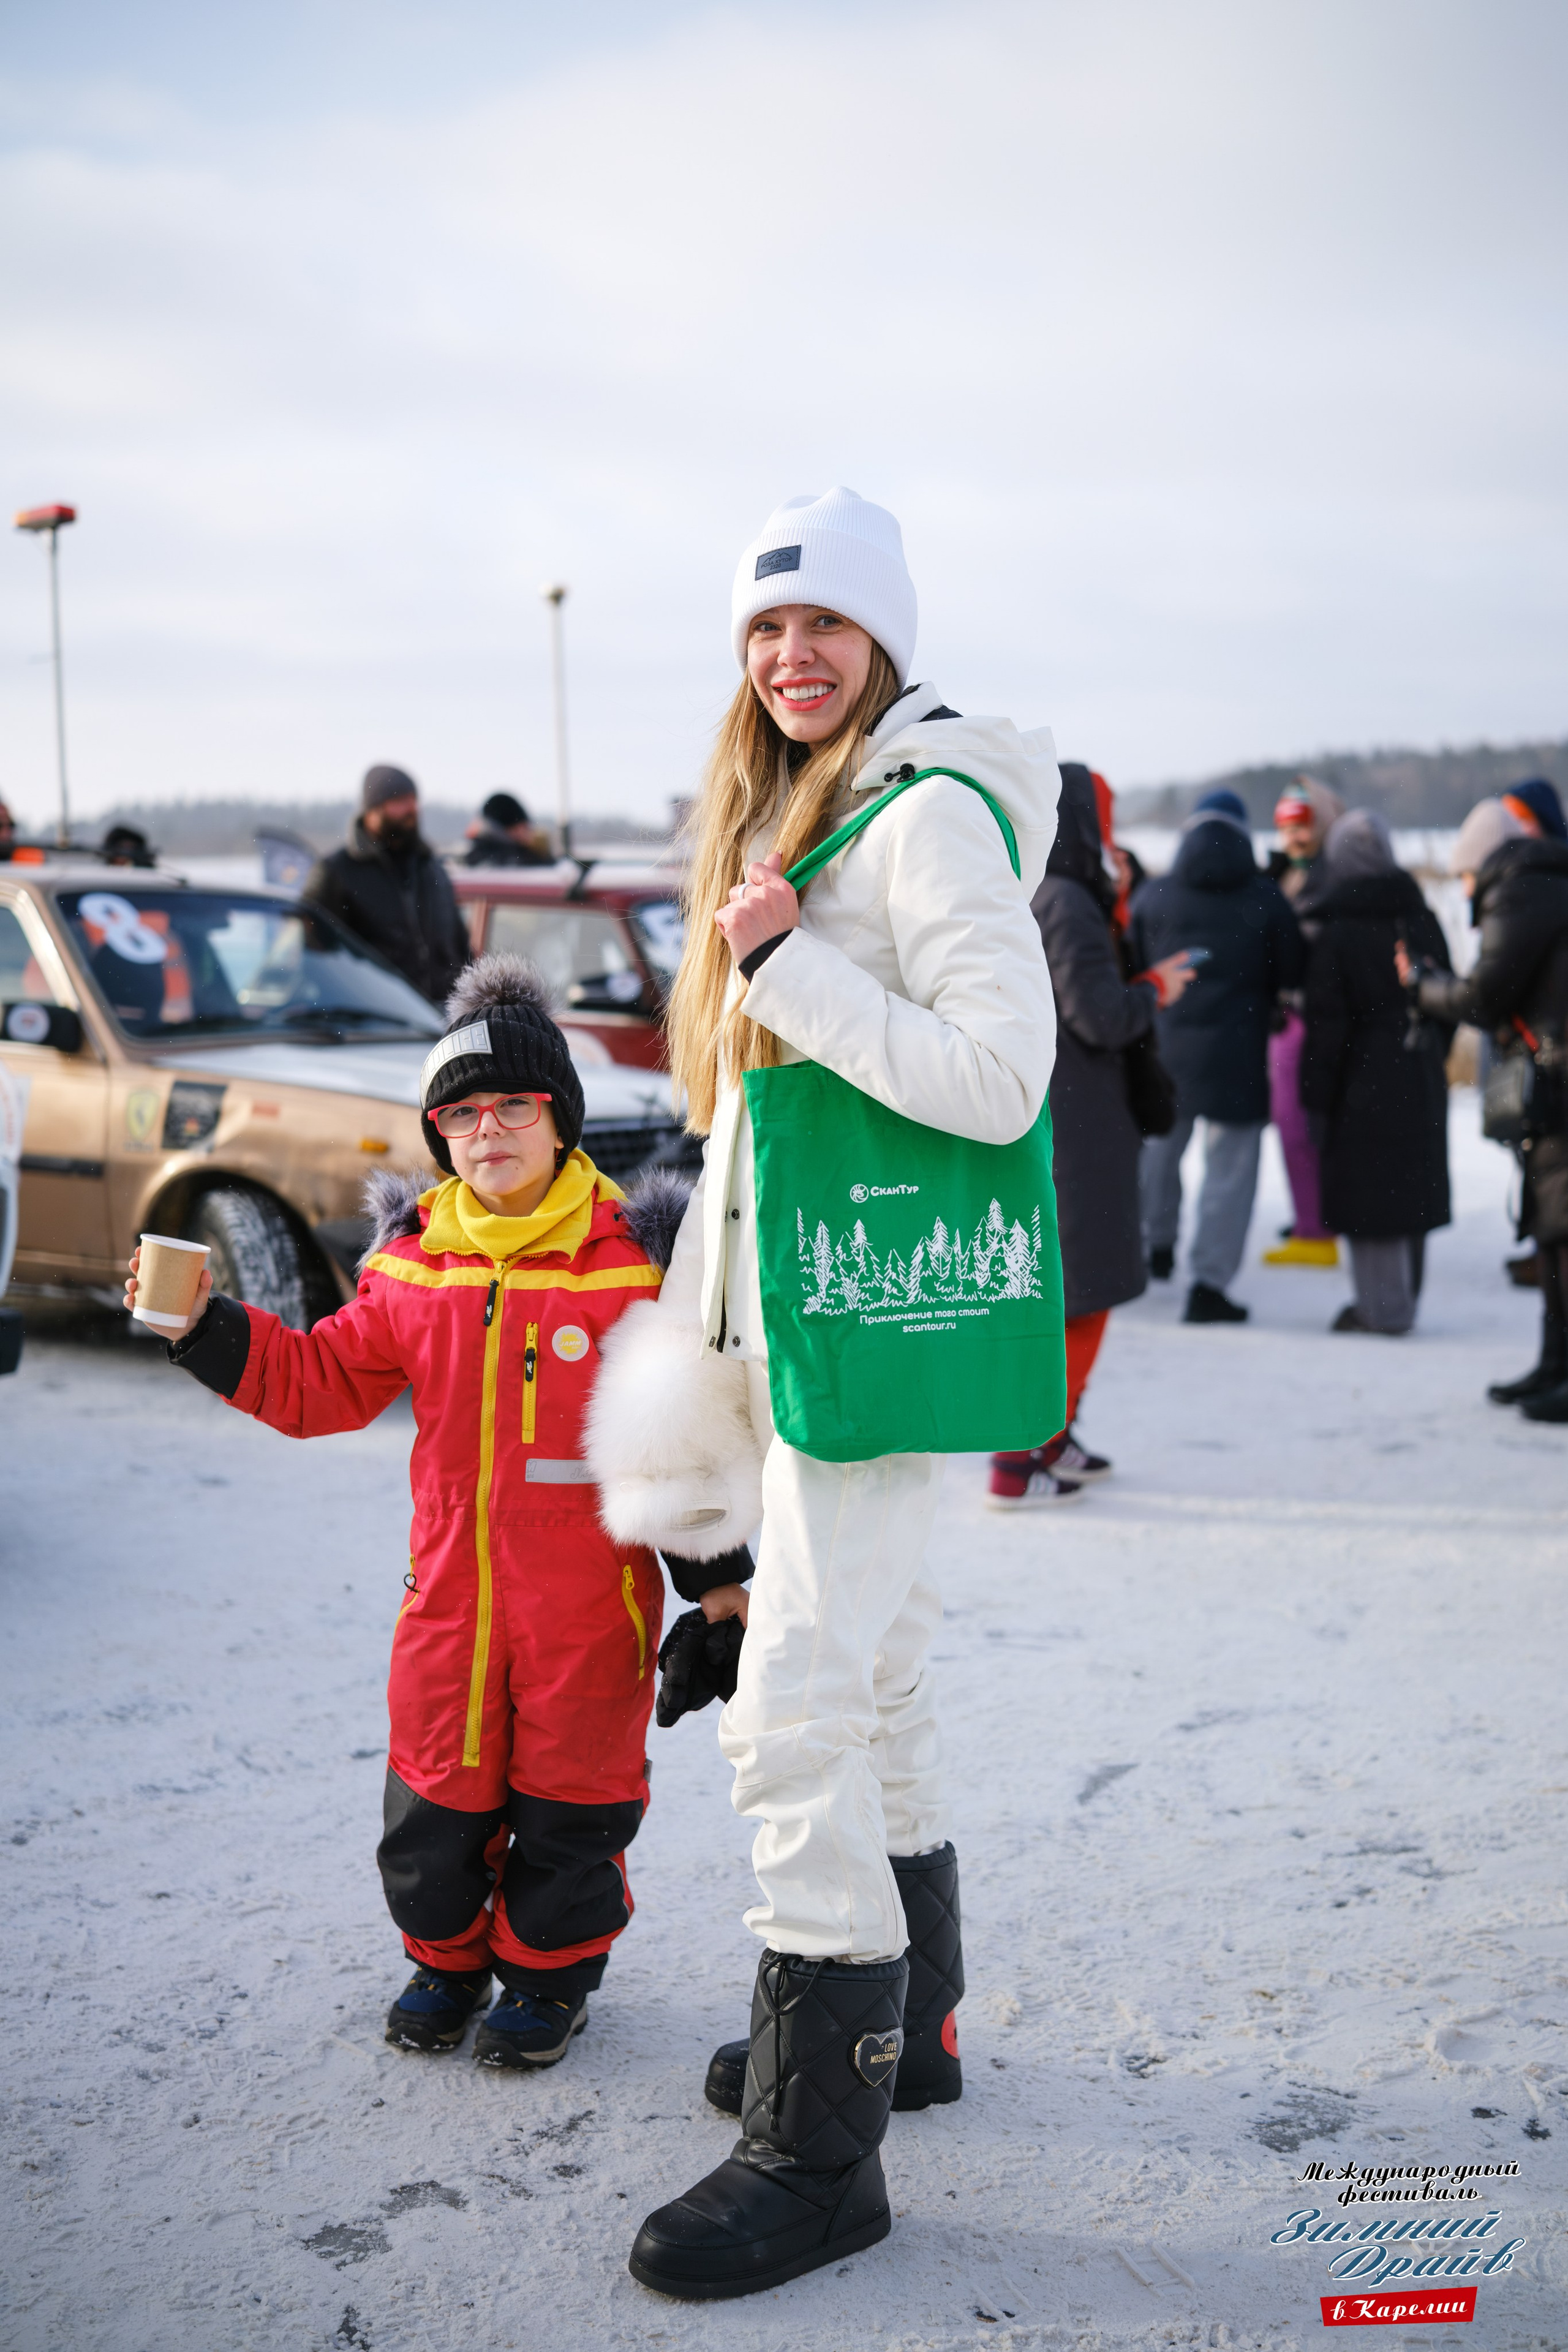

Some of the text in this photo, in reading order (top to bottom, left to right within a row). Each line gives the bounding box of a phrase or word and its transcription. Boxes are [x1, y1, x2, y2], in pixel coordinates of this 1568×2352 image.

[859, 1310, 932, 1325] Приключение
[958, 1308, 989, 1317] стоит
[902, 1322, 956, 1333] scantour.ru
[884, 2042, 897, 2052] LOVE
[870, 2052, 897, 2064] MOSCHINO
